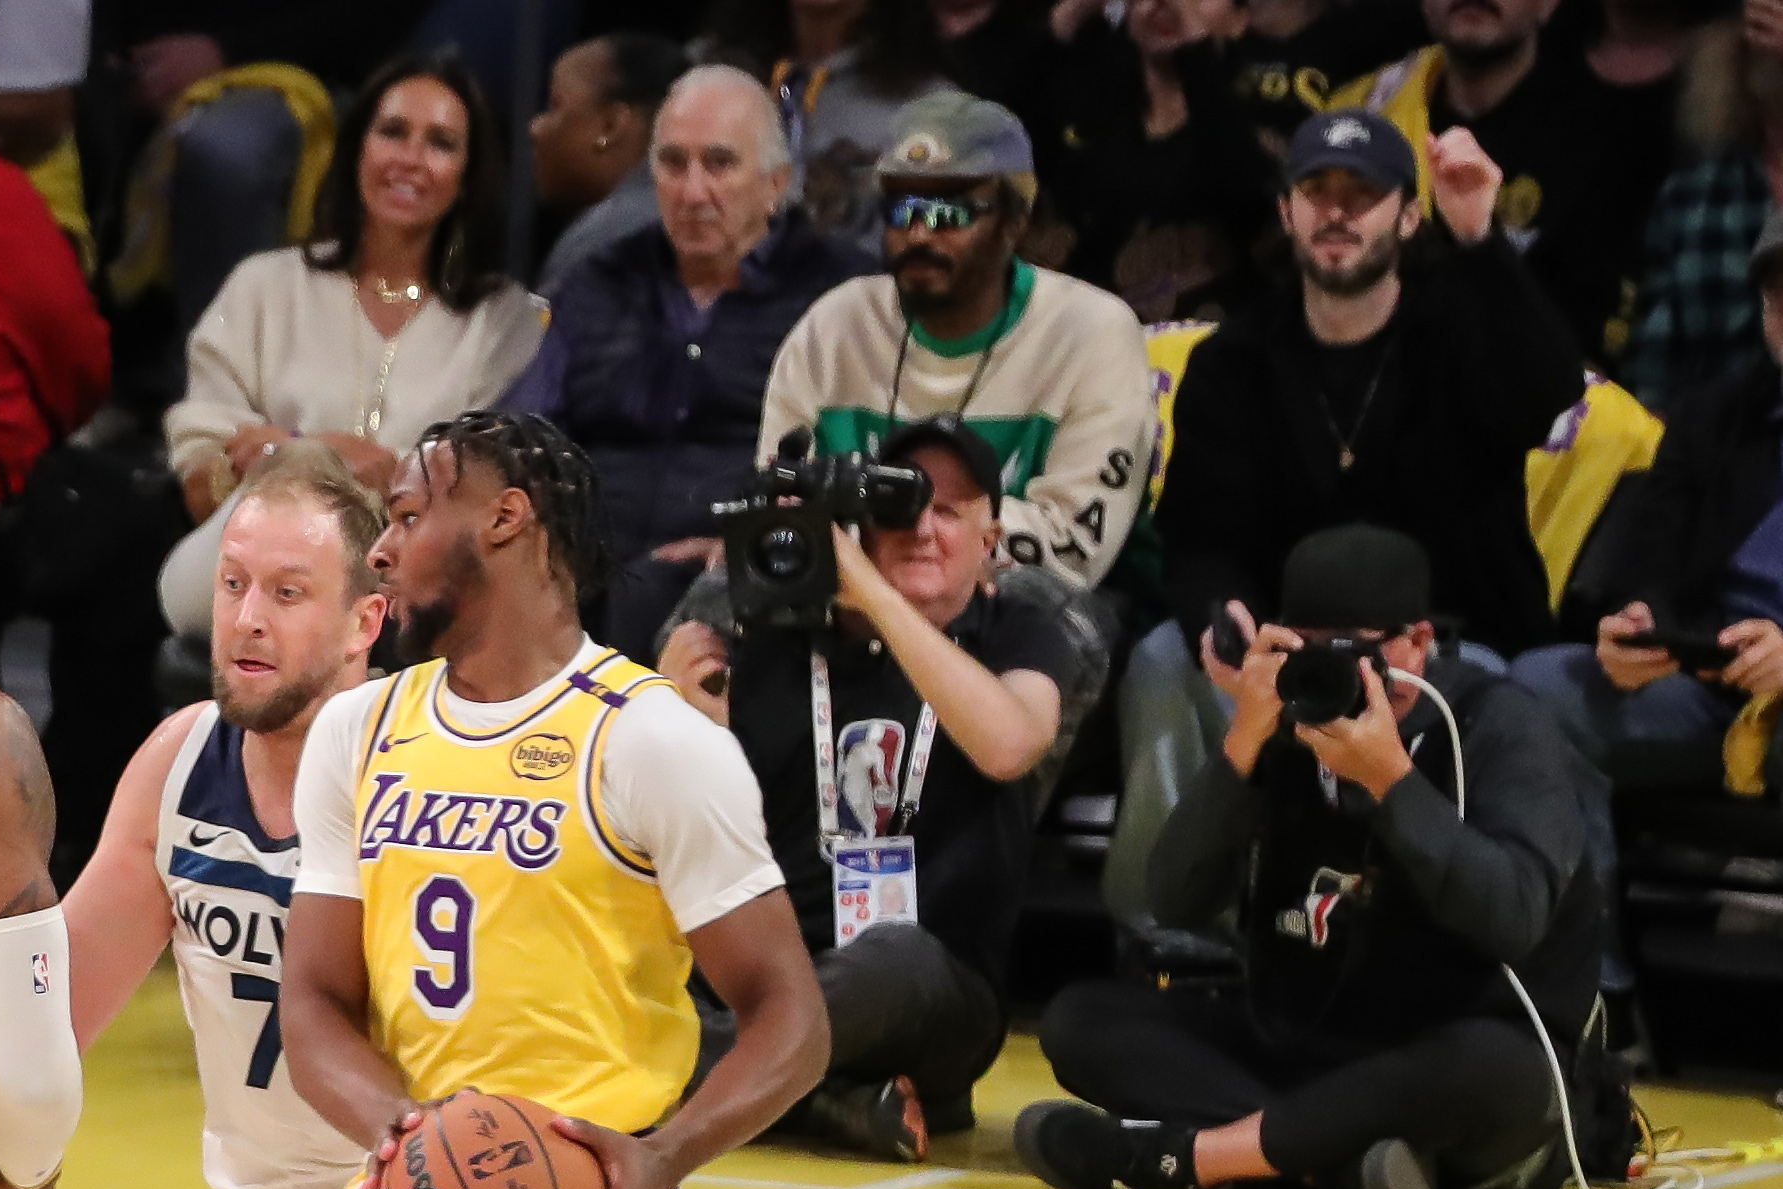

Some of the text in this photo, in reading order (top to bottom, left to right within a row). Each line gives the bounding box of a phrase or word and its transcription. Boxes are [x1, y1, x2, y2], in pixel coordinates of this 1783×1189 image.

[516, 744, 571, 768] bibigo
[358, 772, 569, 871] LAKERS
[413, 873, 477, 1019] 9
[230, 972, 283, 1089] 7
